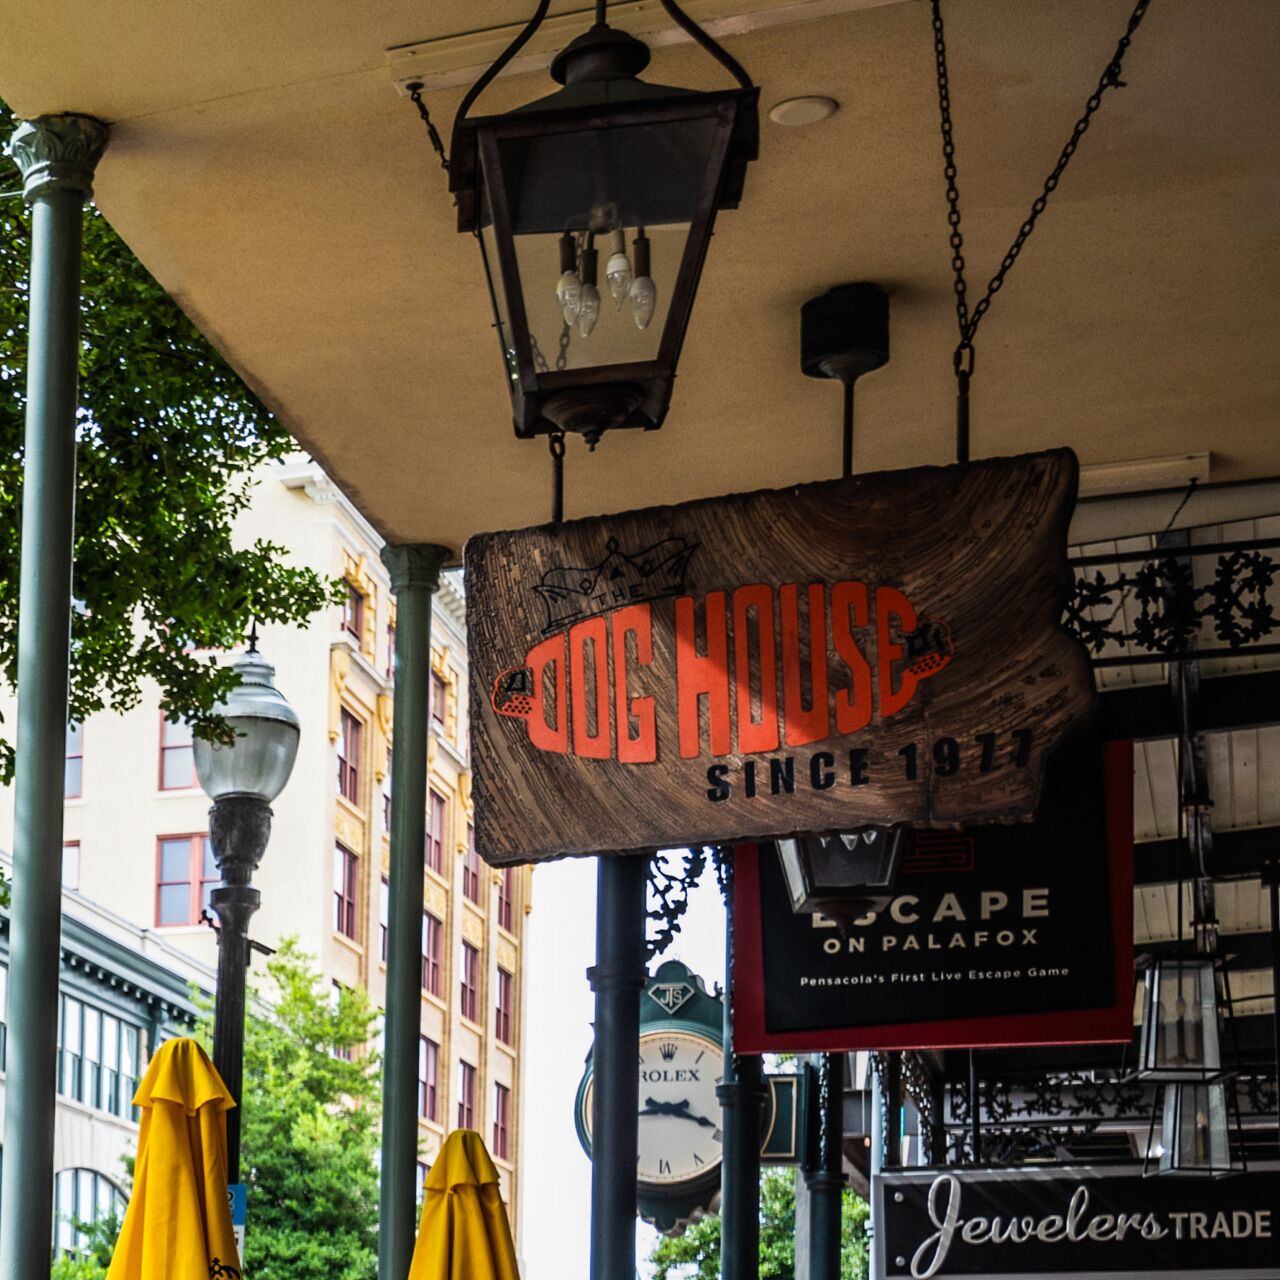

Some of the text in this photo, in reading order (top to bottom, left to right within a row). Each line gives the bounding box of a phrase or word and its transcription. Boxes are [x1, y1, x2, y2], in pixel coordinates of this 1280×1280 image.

[591, 583, 645, 606] THE
[524, 580, 919, 764] DOG HOUSE
[706, 747, 870, 802] SINCE
[823, 929, 1038, 954] ON PALAFOX
[800, 966, 1069, 987] Pensacola's First Live Escape Game
[910, 1174, 1272, 1280] Jewelers TRADE
